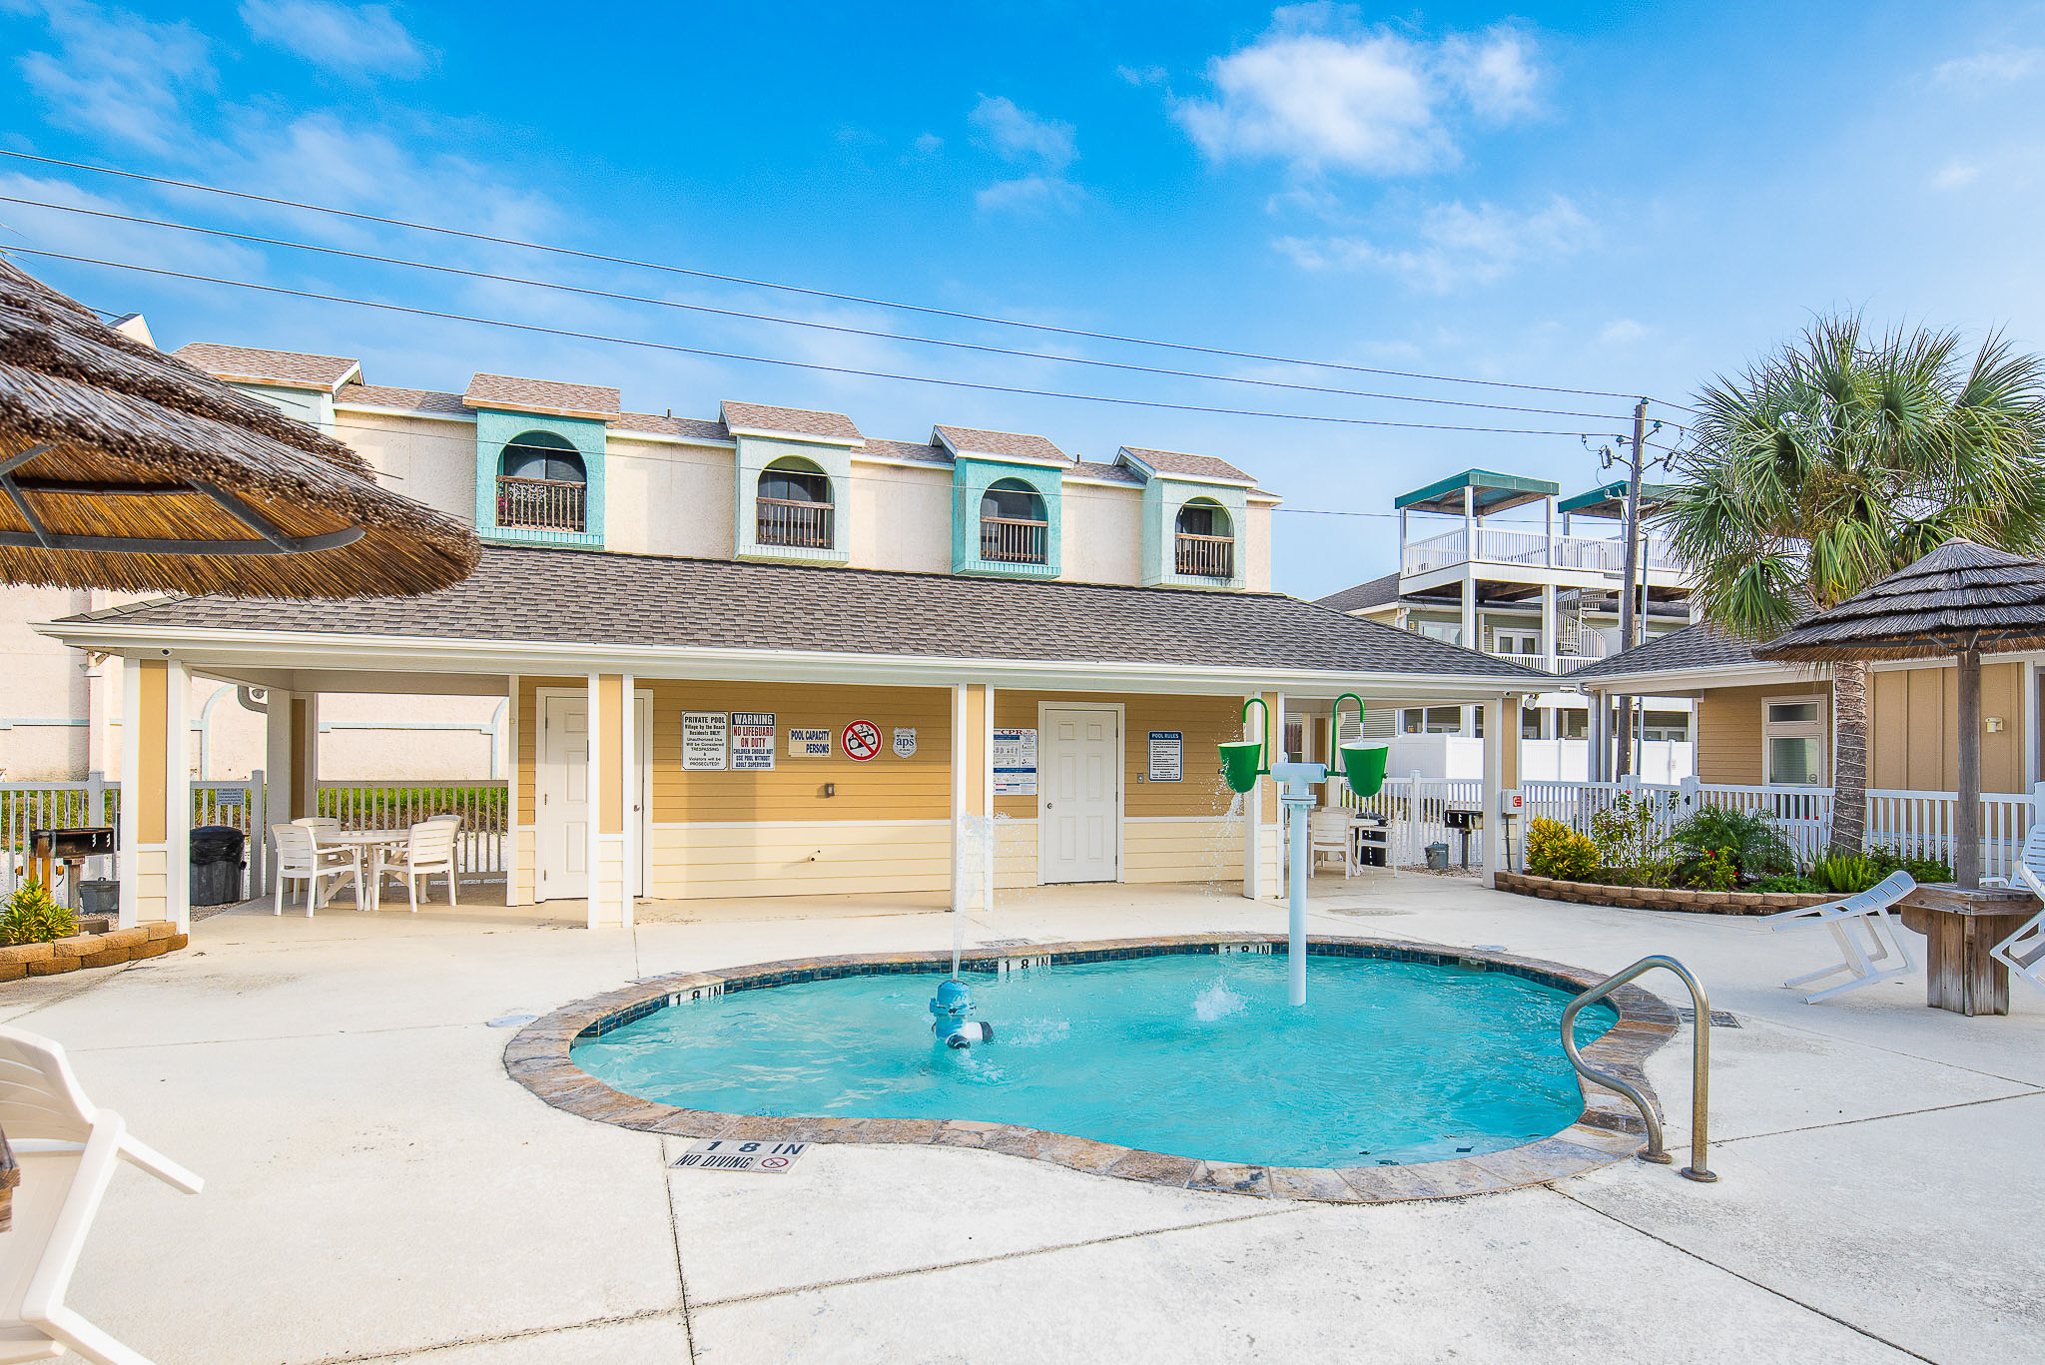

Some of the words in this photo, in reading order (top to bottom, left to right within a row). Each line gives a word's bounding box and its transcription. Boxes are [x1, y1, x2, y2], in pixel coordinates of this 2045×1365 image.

[735, 714, 773, 725] WARNING
[734, 727, 741, 736] NO
[743, 727, 773, 736] LIFEGUARD
[791, 730, 804, 740] POOL
[806, 730, 829, 740] CAPACITY
[741, 738, 748, 747] ON
[751, 738, 766, 747] DUTY
[896, 738, 914, 748] aps
[806, 744, 829, 753] PERSONS
[1256, 945, 1269, 955] IN
[1036, 957, 1048, 967] IN
[709, 985, 721, 997] IN
[771, 1143, 805, 1155] IN
[676, 1154, 702, 1166] NO
[700, 1155, 753, 1168] DIVING
